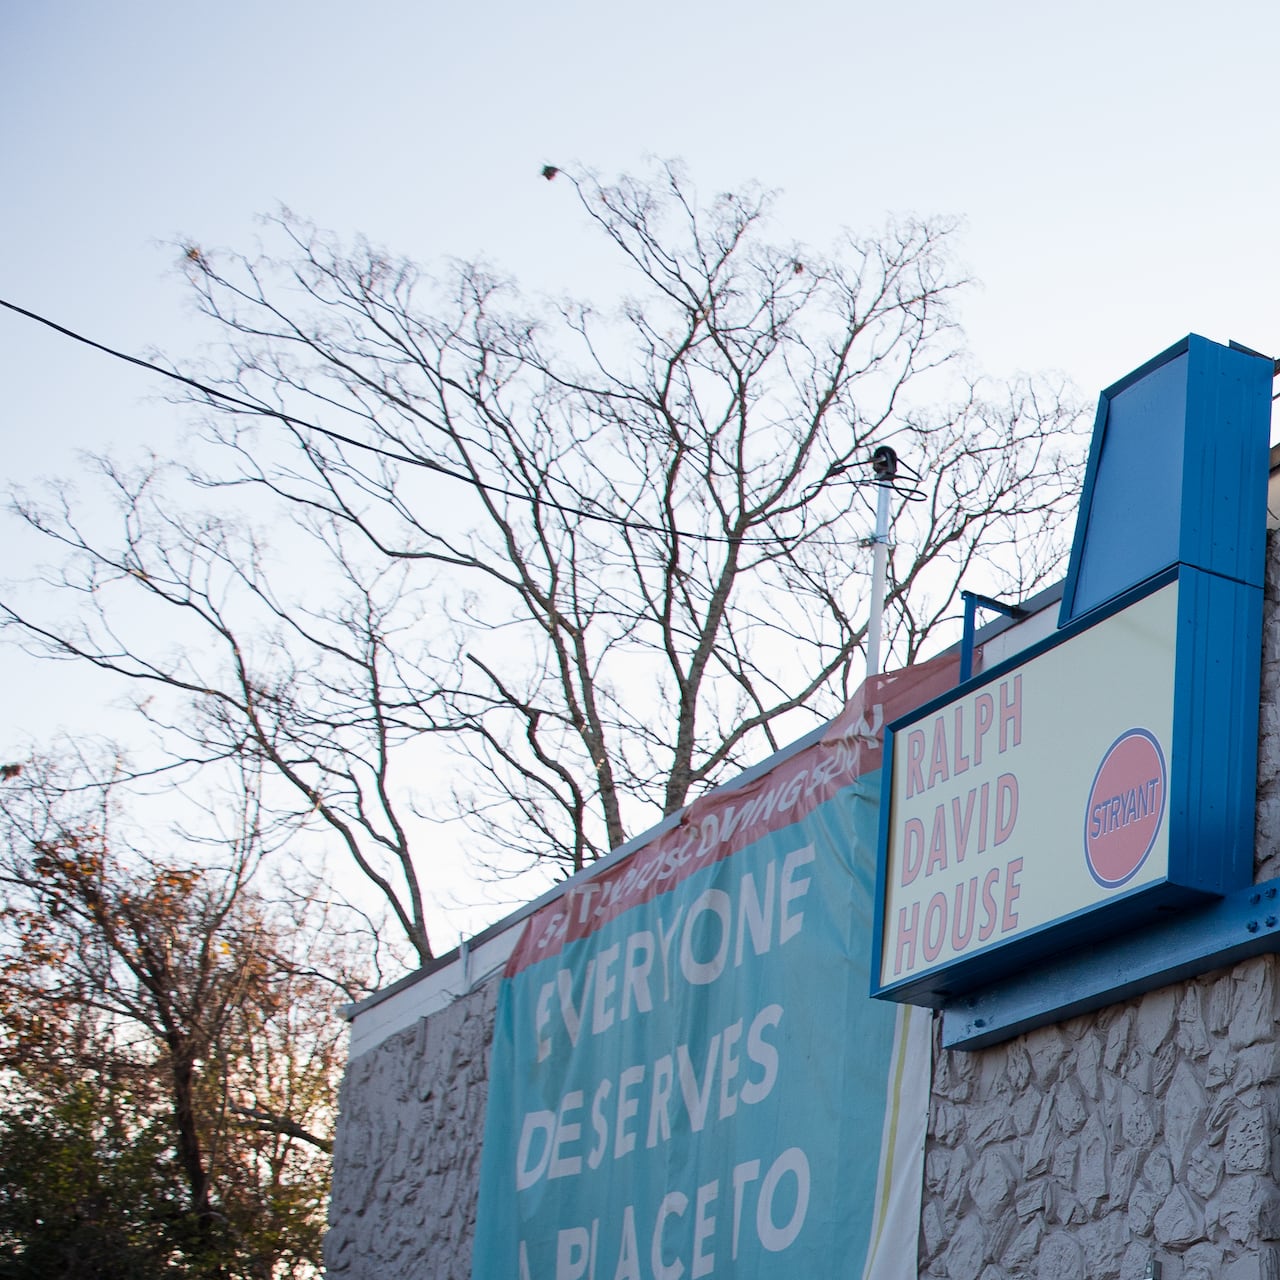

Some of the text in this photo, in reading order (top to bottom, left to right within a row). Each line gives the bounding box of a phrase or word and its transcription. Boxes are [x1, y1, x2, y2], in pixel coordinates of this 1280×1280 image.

[906, 673, 1023, 799] RALPH
[901, 773, 1019, 887] DAVID
[1091, 777, 1159, 840] STRYANT
[535, 842, 816, 1064] EVERYONE
[893, 857, 1024, 976] HOUSE
[516, 1004, 785, 1193] DESERVES
[731, 1147, 811, 1260] TO
